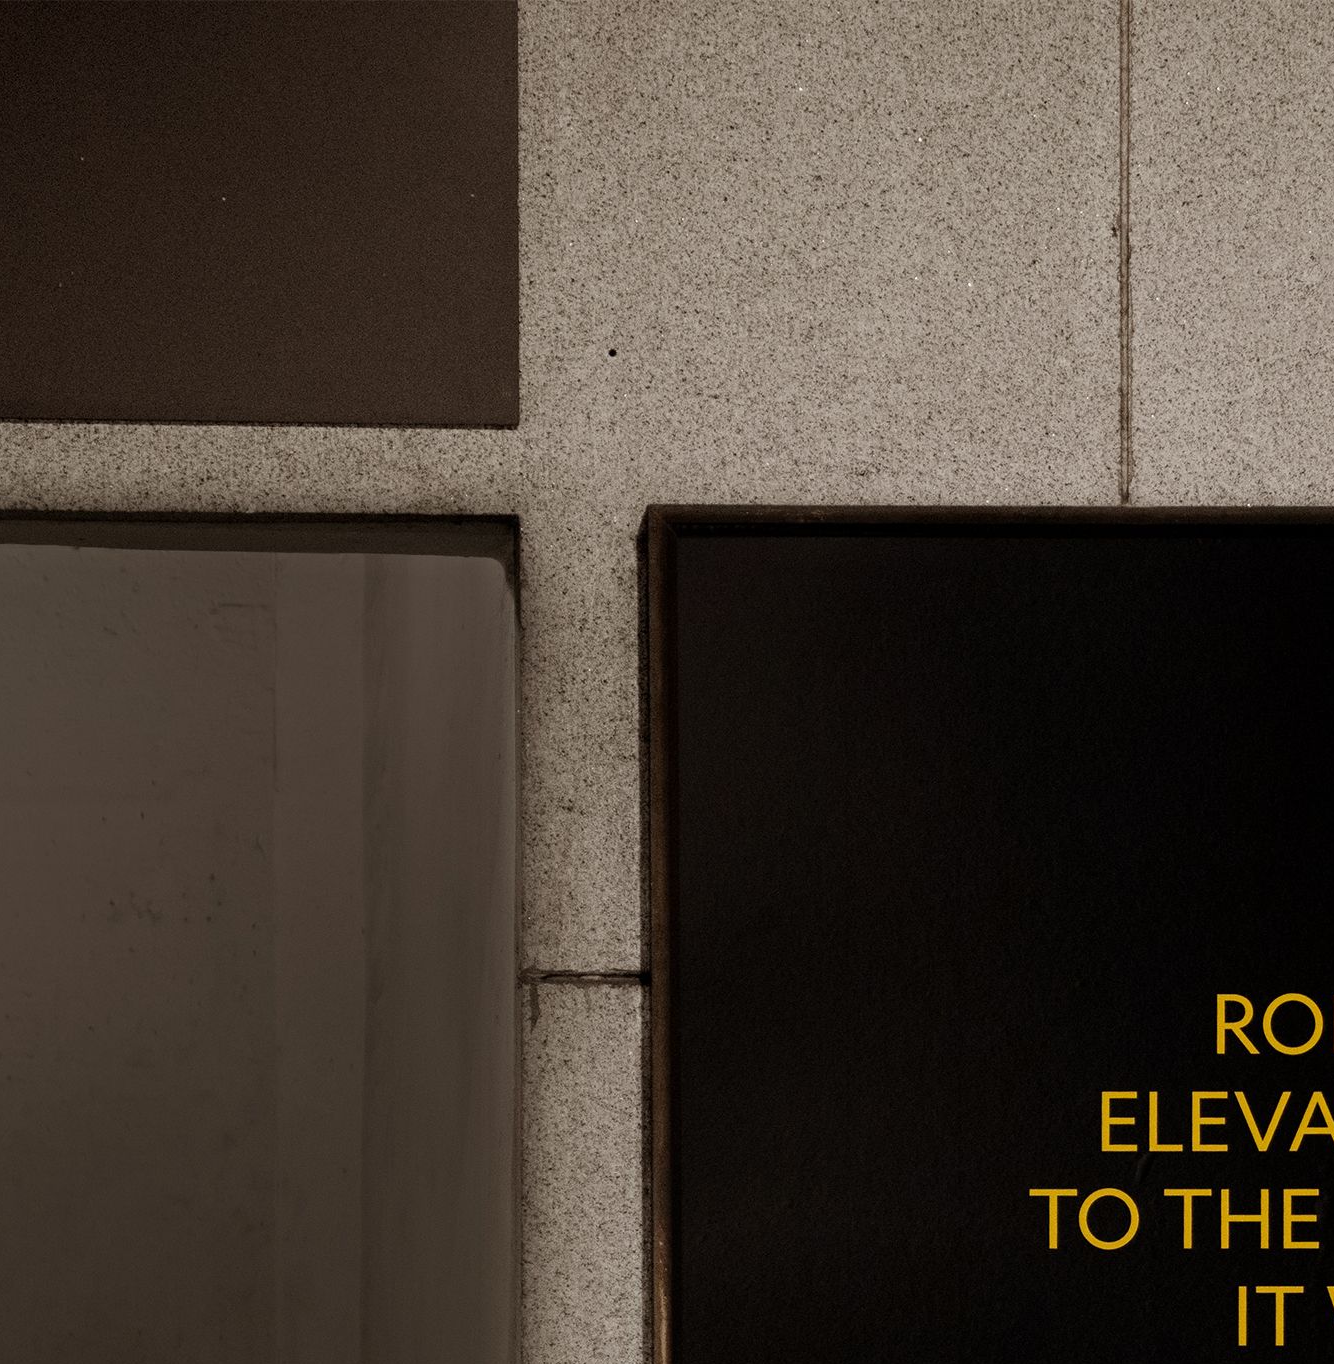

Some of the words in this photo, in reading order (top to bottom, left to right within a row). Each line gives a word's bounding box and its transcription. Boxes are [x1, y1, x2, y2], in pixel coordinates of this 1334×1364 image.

[1028, 1187, 1140, 1251] TO
[1163, 1188, 1320, 1250] THE
[1238, 1285, 1305, 1347] IT
